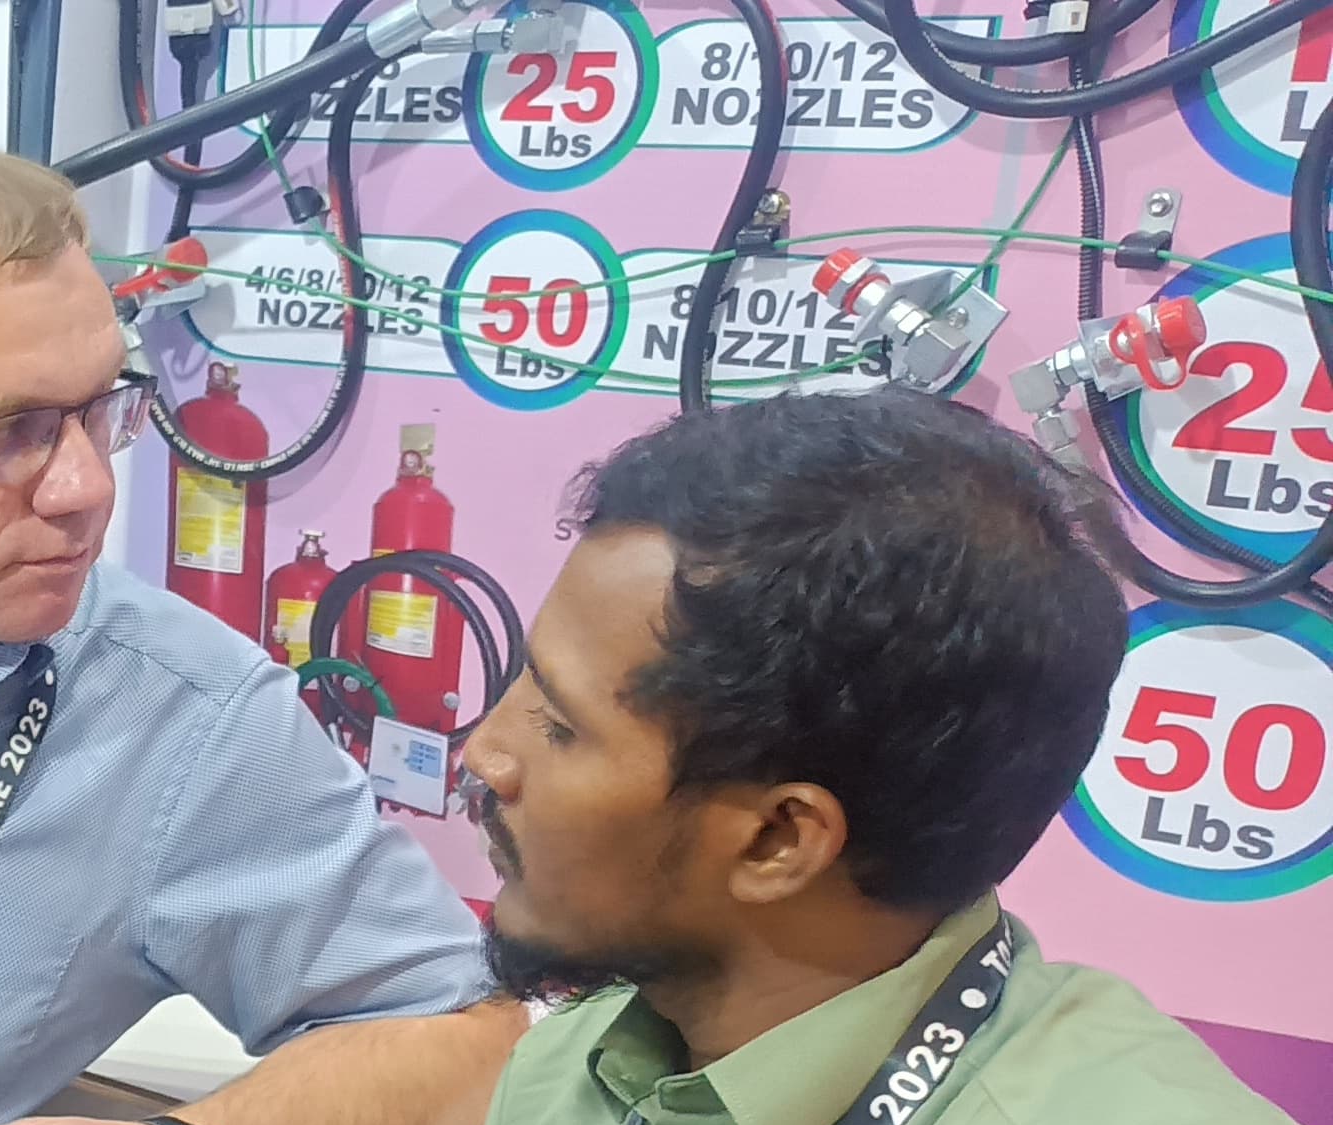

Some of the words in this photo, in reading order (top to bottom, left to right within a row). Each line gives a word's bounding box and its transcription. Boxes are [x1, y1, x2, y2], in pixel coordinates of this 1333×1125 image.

[500, 51, 617, 124] 25
[519, 127, 593, 159] Lbs
[478, 276, 589, 348] 50
[495, 345, 566, 381] Lbs
[1113, 686, 1327, 811] 50
[1141, 796, 1275, 861] Lbs
